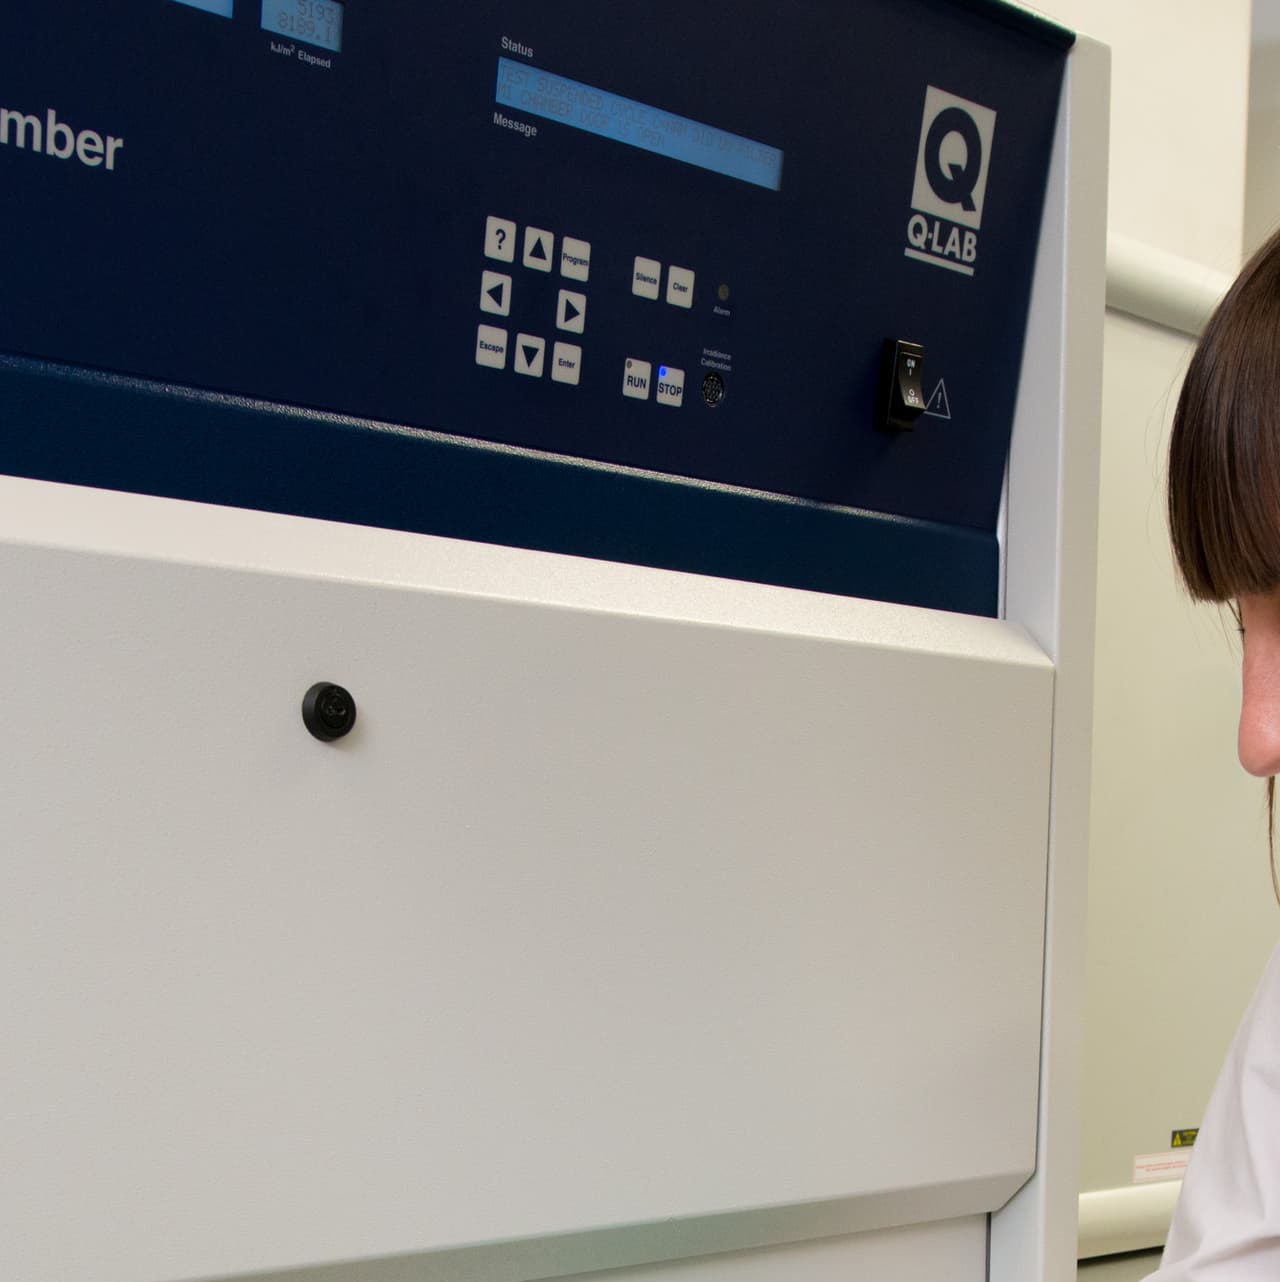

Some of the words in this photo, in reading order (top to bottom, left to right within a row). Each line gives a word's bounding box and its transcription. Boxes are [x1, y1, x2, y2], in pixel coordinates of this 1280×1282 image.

[501, 36, 535, 58] Status
[297, 50, 332, 69] Elapsed
[493, 112, 538, 137] Message
[923, 106, 983, 212] Q
[495, 228, 507, 250] ?
[562, 253, 589, 267] Program
[635, 272, 658, 286] Silence
[672, 282, 689, 293] Clear
[479, 340, 505, 354] Escape
[557, 358, 576, 369] Enter
[700, 357, 732, 372] Calibration
[626, 375, 647, 390] RUN
[658, 383, 683, 397] STOP
